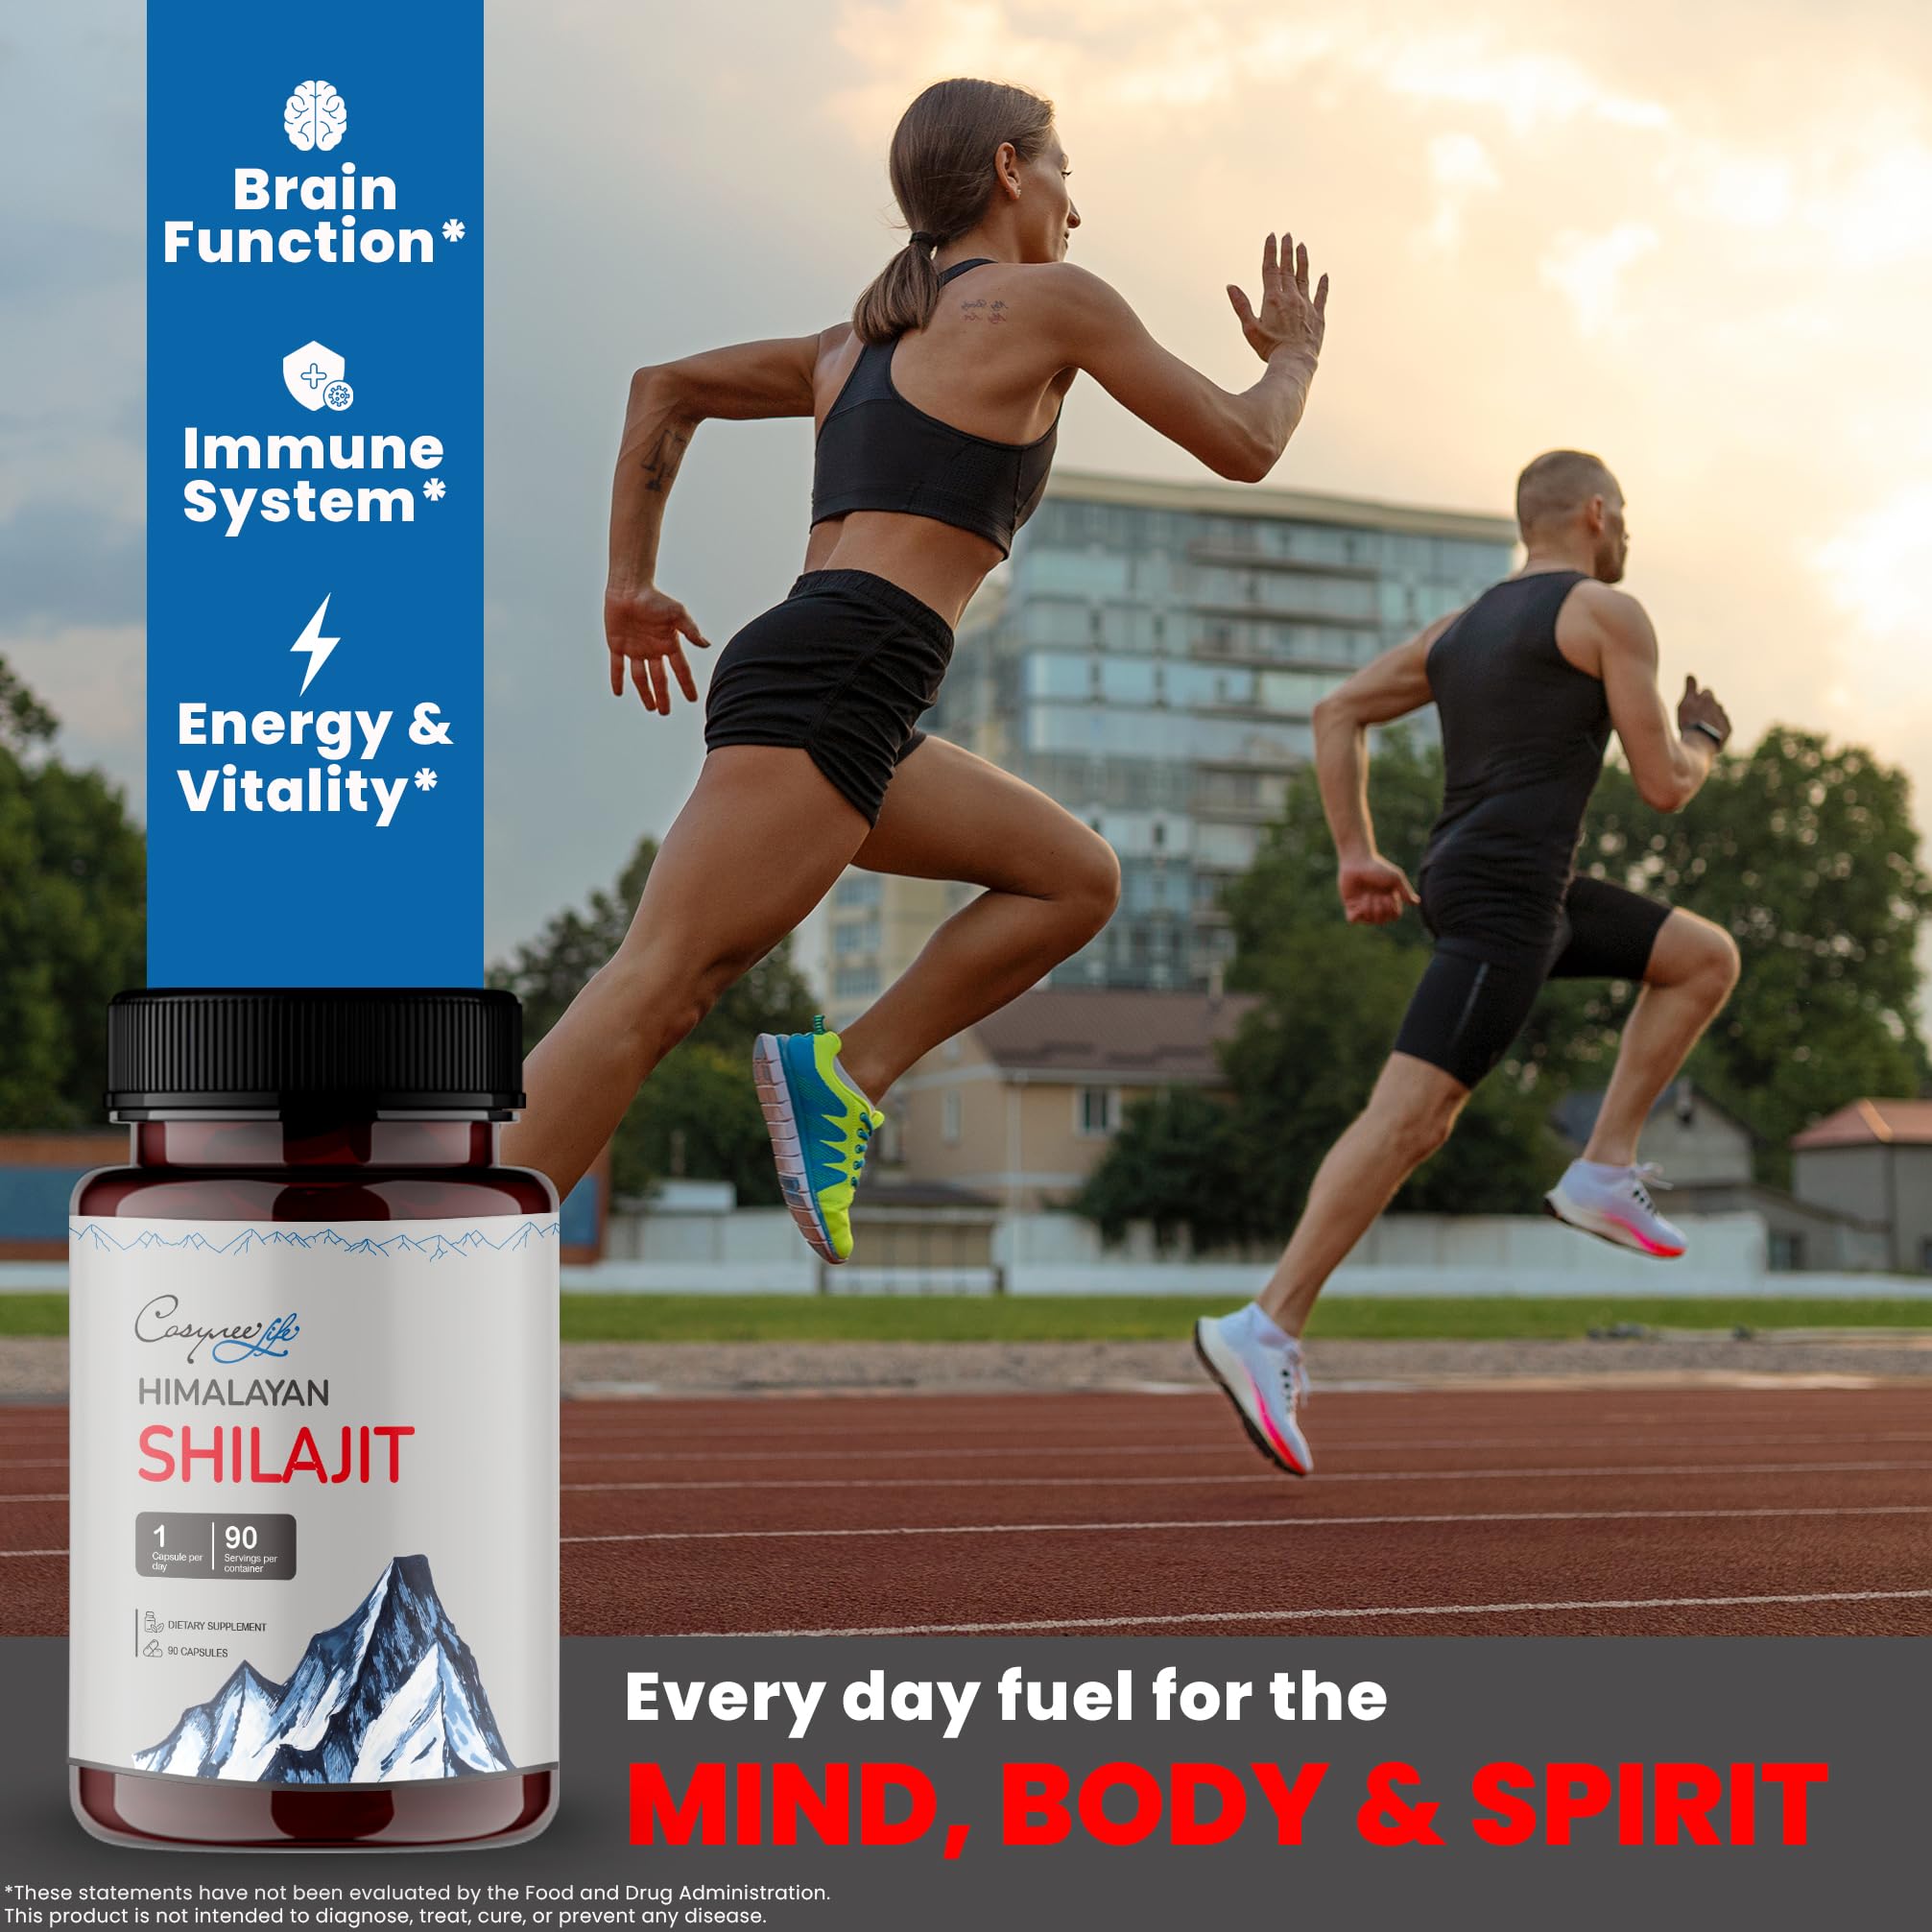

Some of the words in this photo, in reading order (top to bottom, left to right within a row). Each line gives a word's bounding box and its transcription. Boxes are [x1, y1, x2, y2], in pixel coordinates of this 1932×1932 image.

[138, 1378, 329, 1407] HIMALAYAN
[138, 1424, 416, 1485] SHILAJIT
[153, 1523, 166, 1548] 1
[225, 1525, 258, 1550] 90
[152, 1551, 187, 1563] Capsule
[188, 1554, 204, 1564] per
[224, 1553, 262, 1566] Servings
[263, 1556, 278, 1565] per
[152, 1562, 169, 1572] day
[224, 1563, 264, 1573] container
[168, 1620, 205, 1631] DIETARY
[207, 1621, 268, 1633] SUPPLEMENT
[167, 1646, 179, 1656] 90
[180, 1647, 228, 1658] CAPSULES
